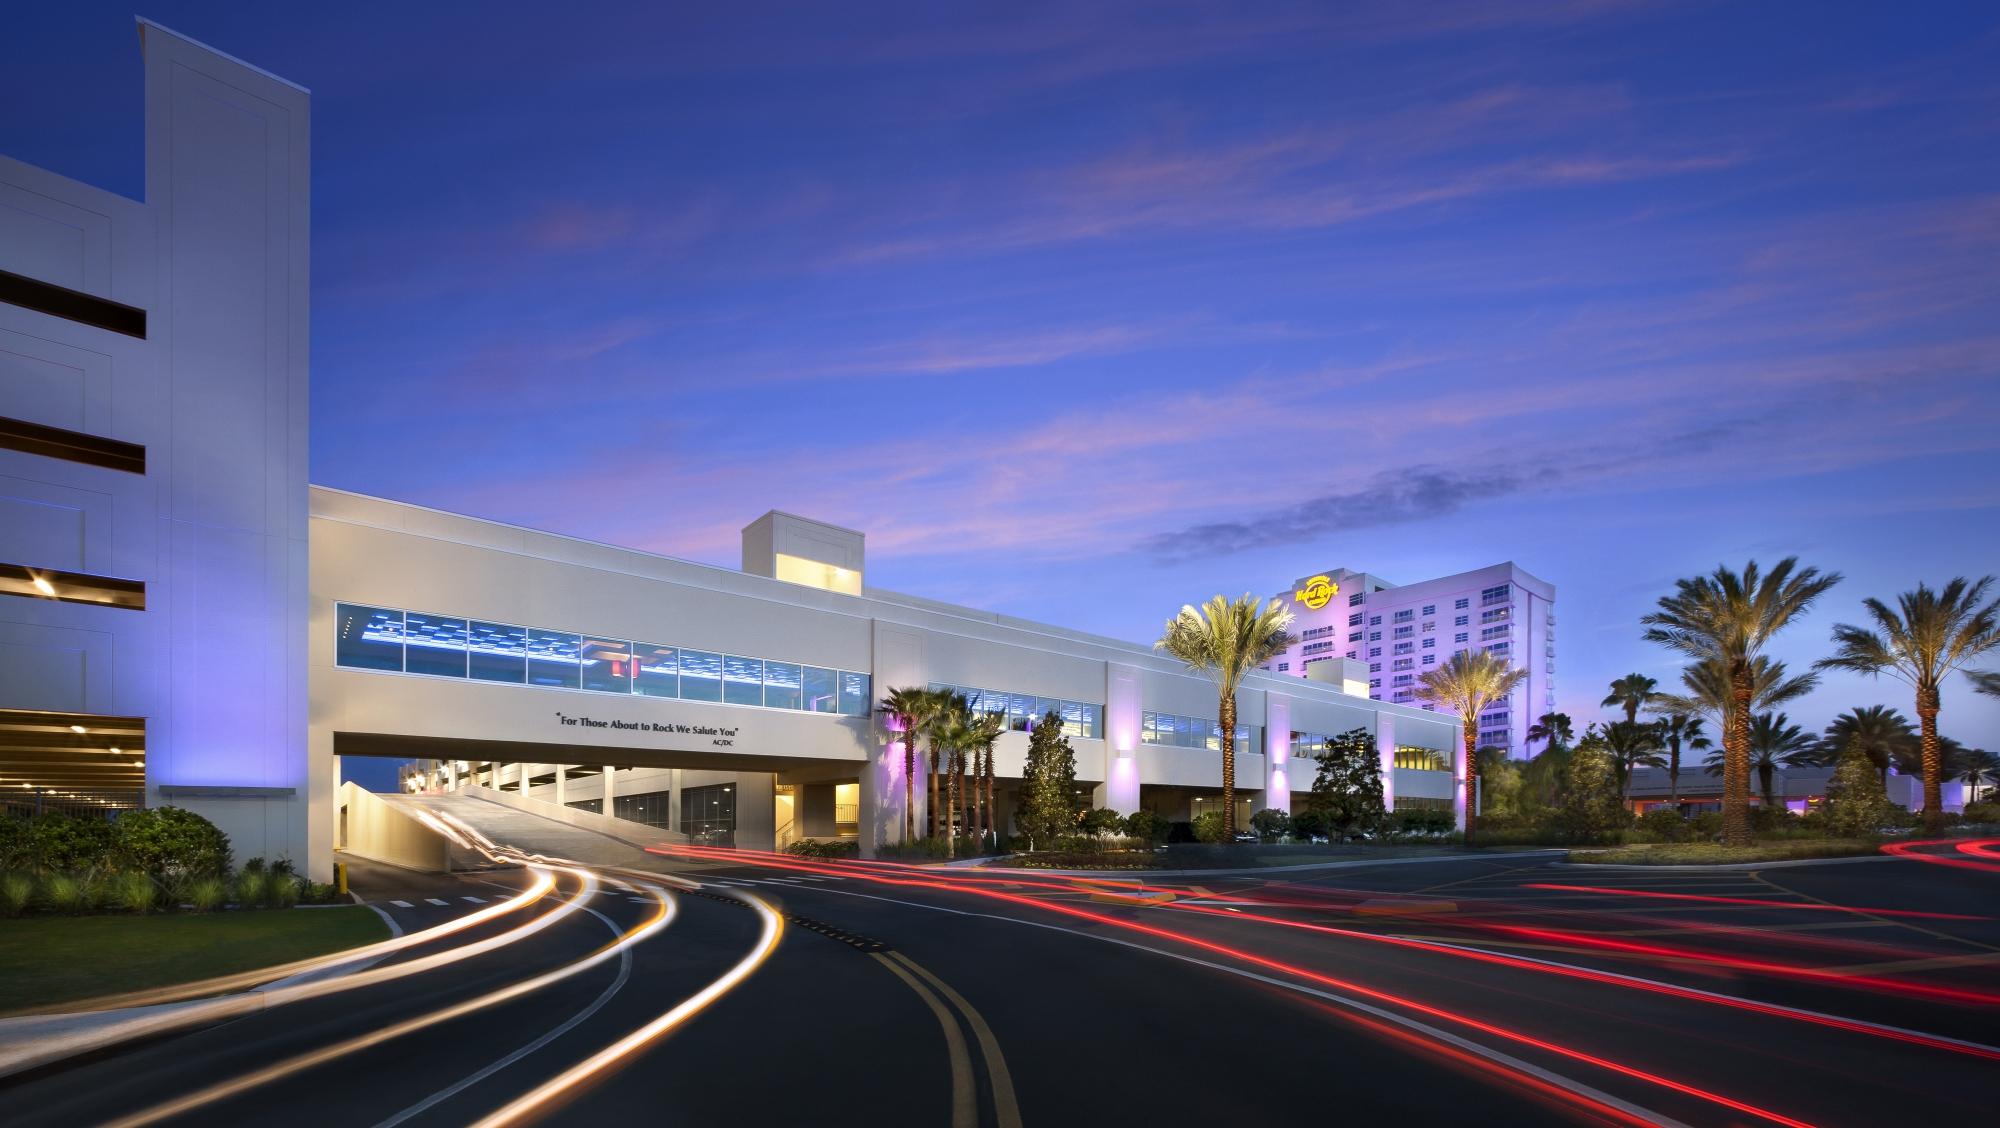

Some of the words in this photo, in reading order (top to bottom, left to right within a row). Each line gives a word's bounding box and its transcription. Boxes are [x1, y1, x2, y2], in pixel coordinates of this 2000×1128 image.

[1295, 588, 1318, 602] Hard
[1317, 583, 1339, 597] Rock
[579, 717, 608, 728] Those
[610, 720, 639, 731] About
[641, 723, 650, 731] to
[653, 723, 675, 733] Rock
[676, 725, 691, 734] We
[692, 726, 718, 736] Salute
[712, 739, 733, 747] AC/DC
